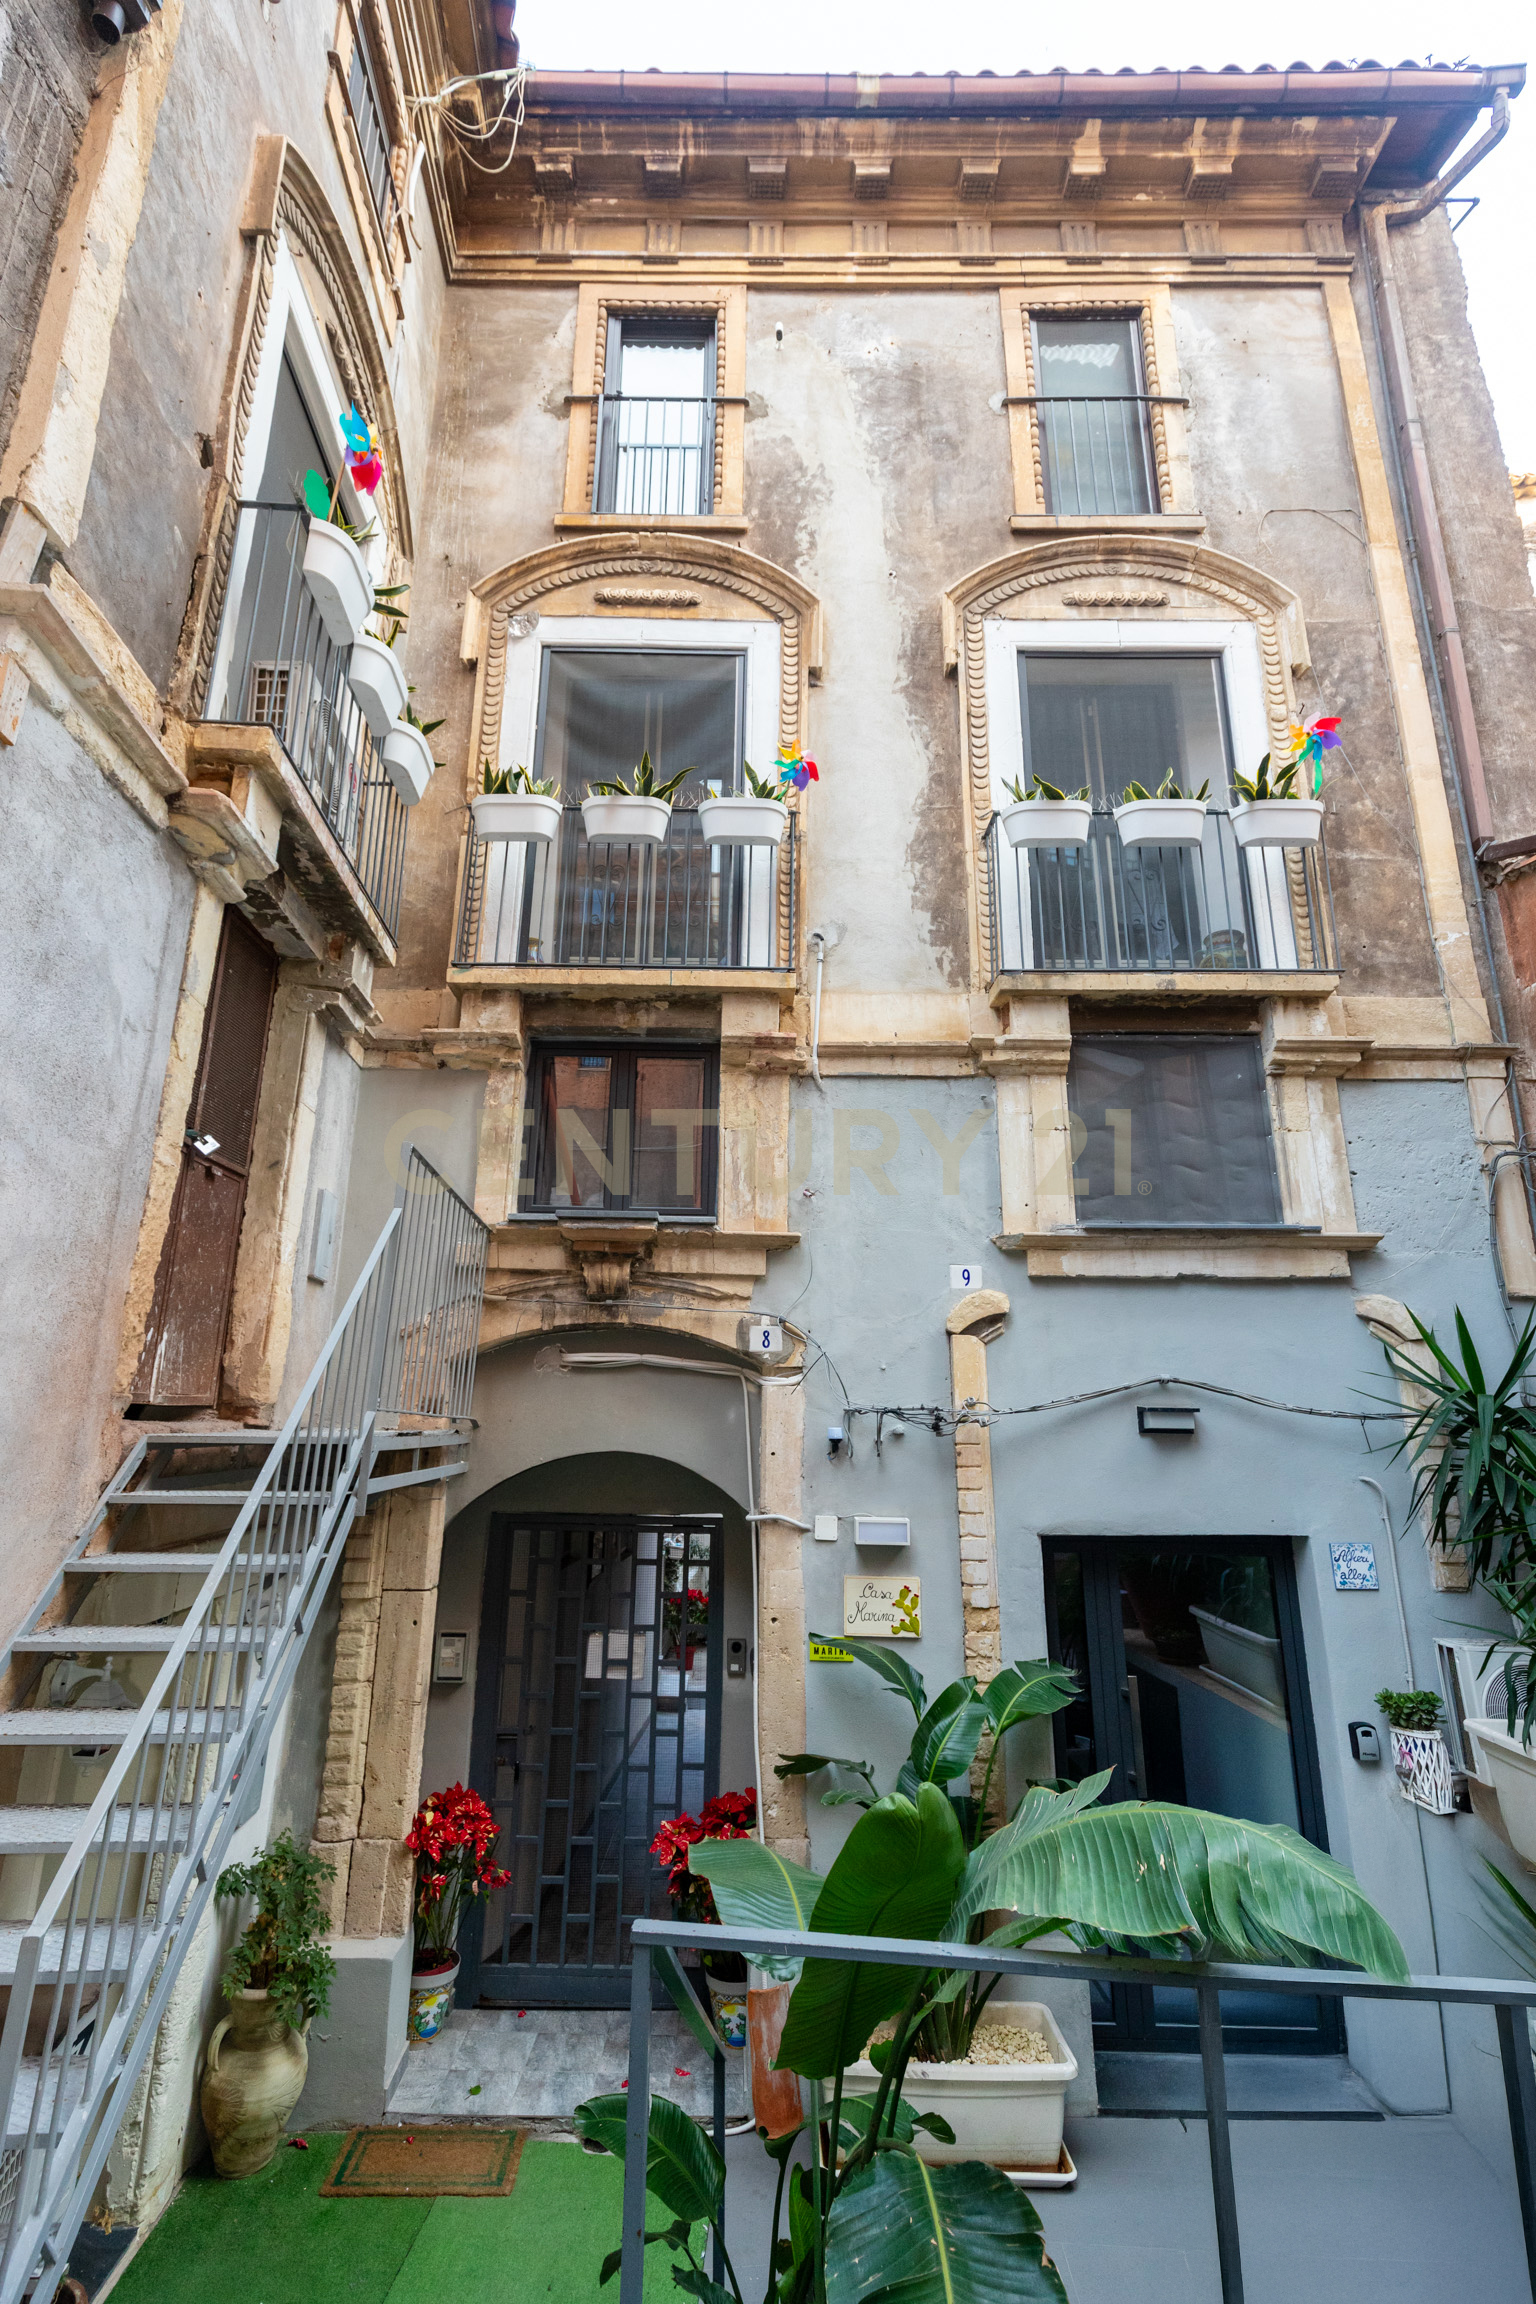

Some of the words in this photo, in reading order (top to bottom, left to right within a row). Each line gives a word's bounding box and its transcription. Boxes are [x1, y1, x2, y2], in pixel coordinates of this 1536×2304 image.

[961, 1268, 971, 1287] 9
[761, 1329, 771, 1349] 8
[1340, 1568, 1368, 1585] alley
[859, 1582, 894, 1600] Casa
[847, 1600, 897, 1624] Marina
